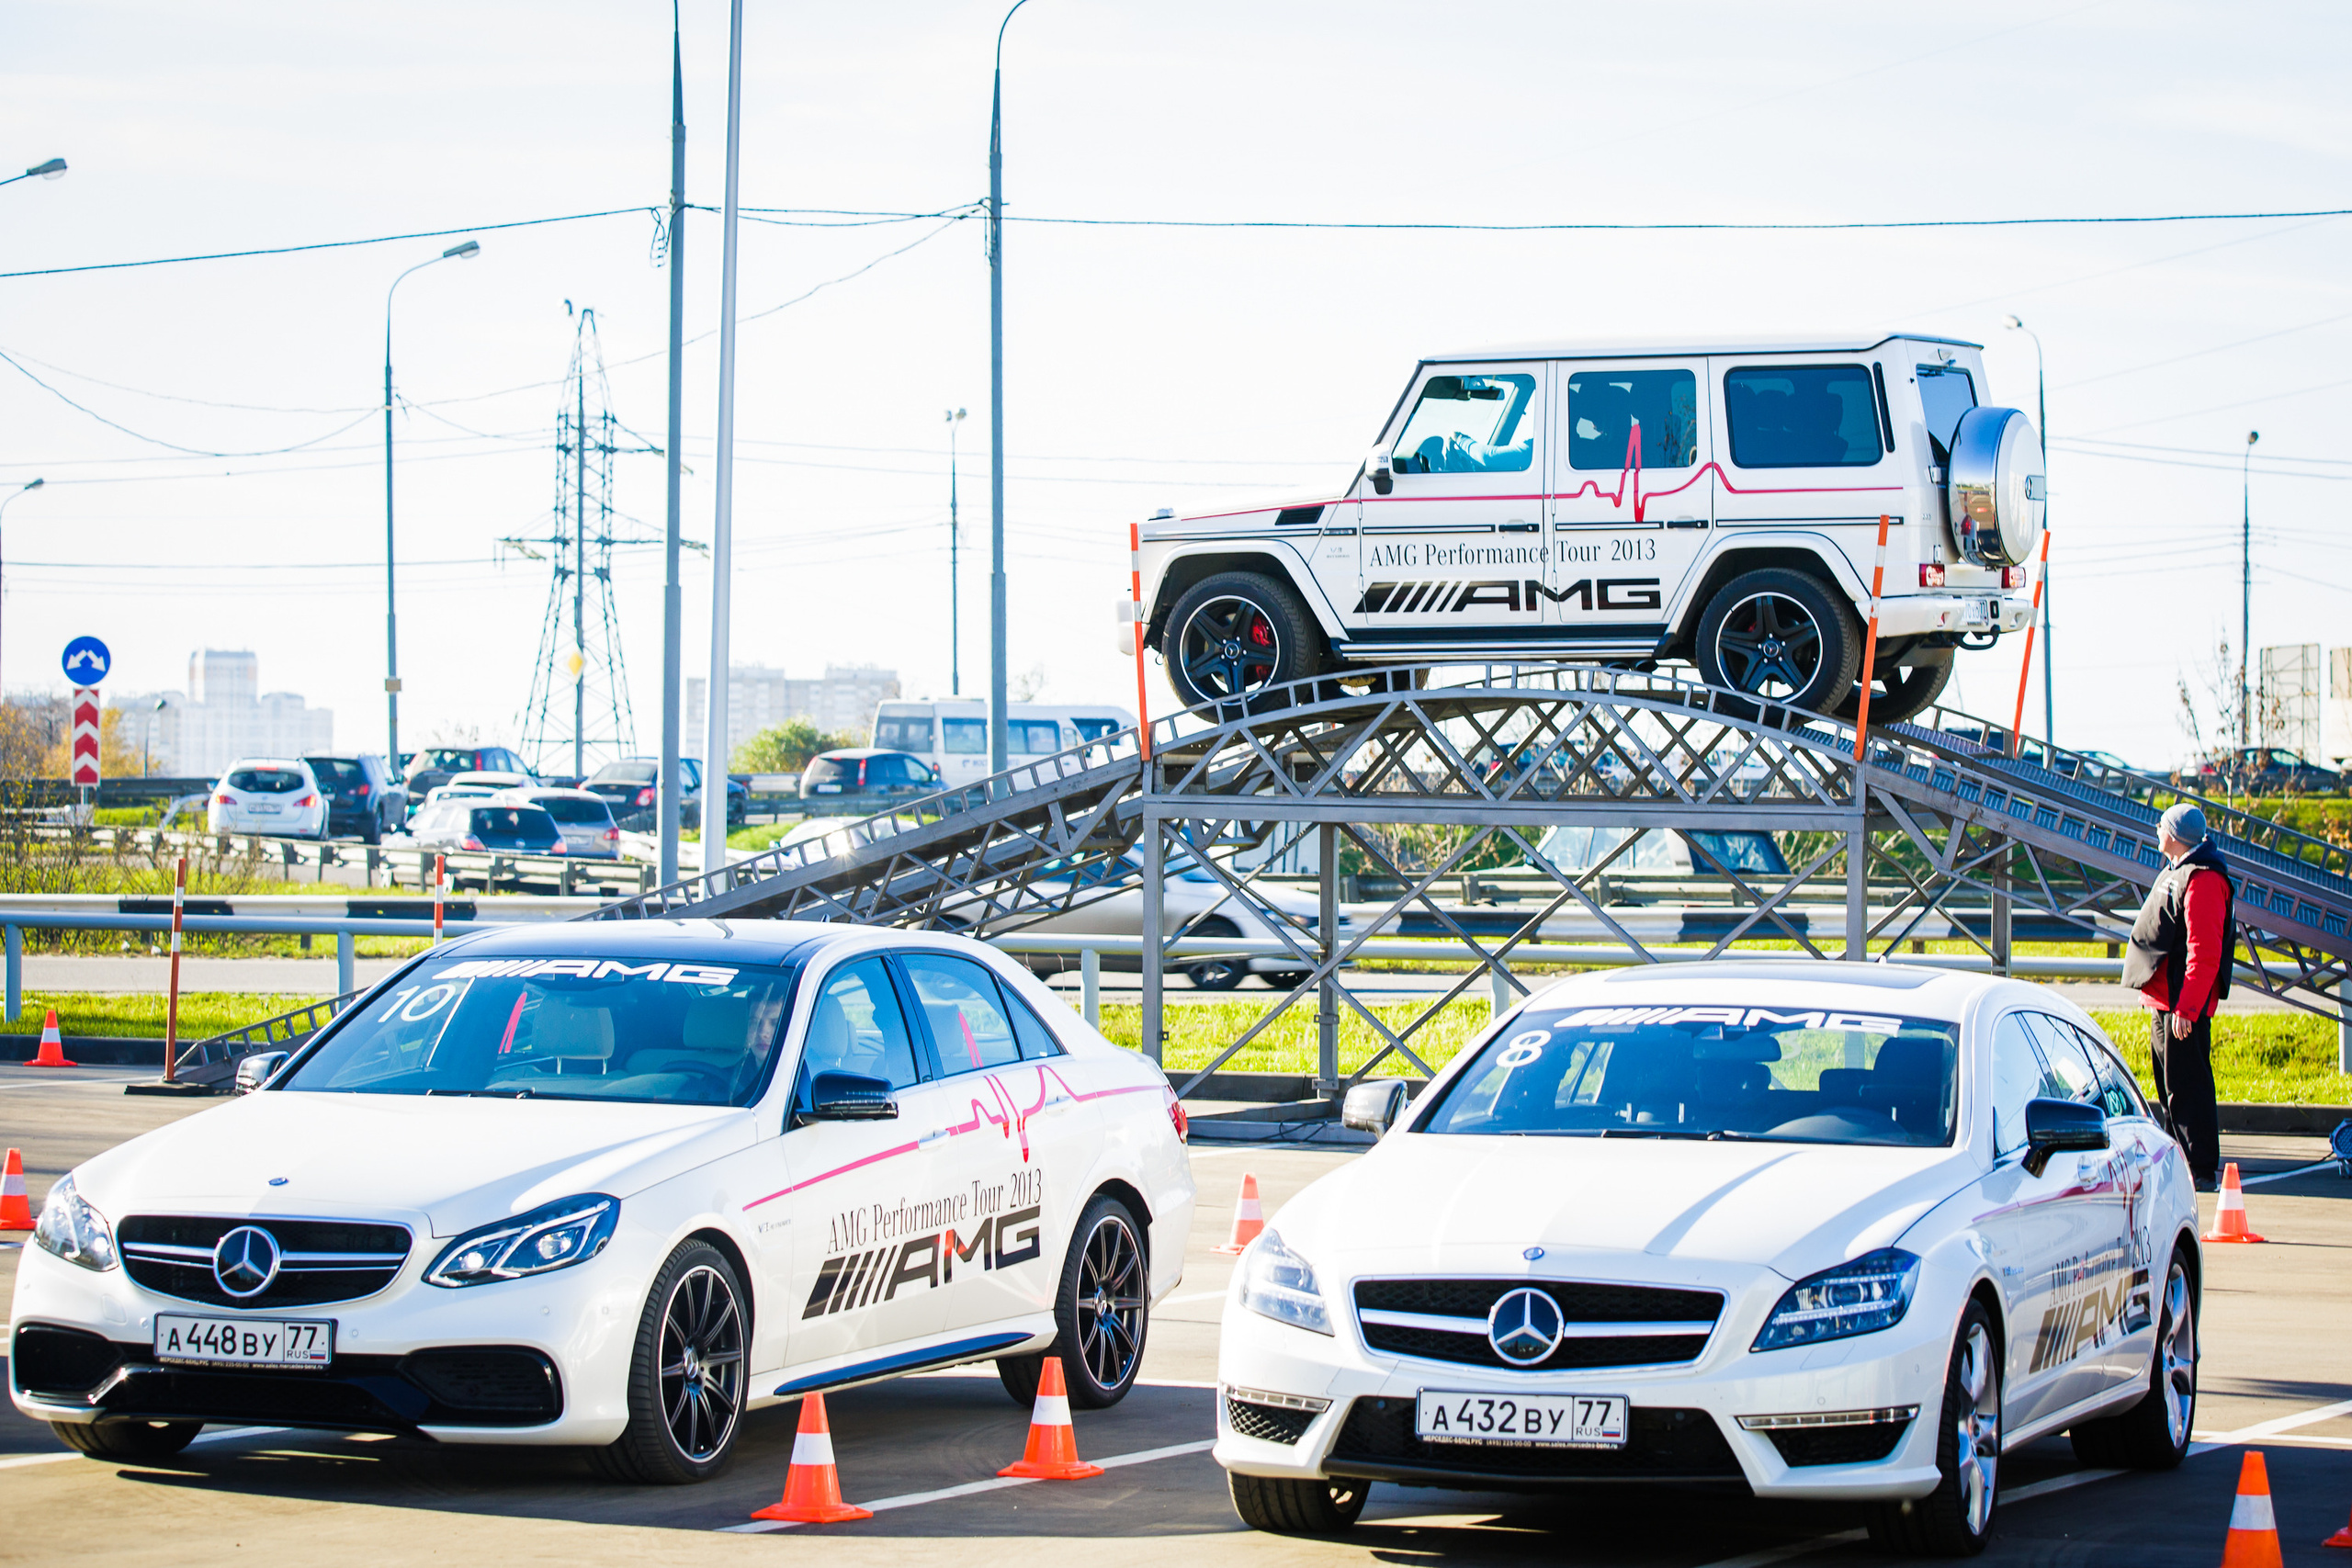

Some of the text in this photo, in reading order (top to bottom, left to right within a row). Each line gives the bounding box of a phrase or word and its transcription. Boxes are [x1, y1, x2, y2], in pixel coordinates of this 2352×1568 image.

[1370, 537, 1656, 566] AMG Performance Tour 2013
[378, 983, 456, 1023] 10
[1496, 1030, 1552, 1067] 8
[827, 1168, 1043, 1255] AMG Performance Tour 2013
[2050, 1258, 2071, 1307] AMG
[2072, 1250, 2116, 1296] Performance
[2132, 1225, 2152, 1269] 2013
[167, 1323, 318, 1357] А448ВУ 77
[287, 1349, 310, 1359] RUS
[1432, 1399, 1612, 1434] А432ВУ 77
[1576, 1427, 1601, 1437] RUS
